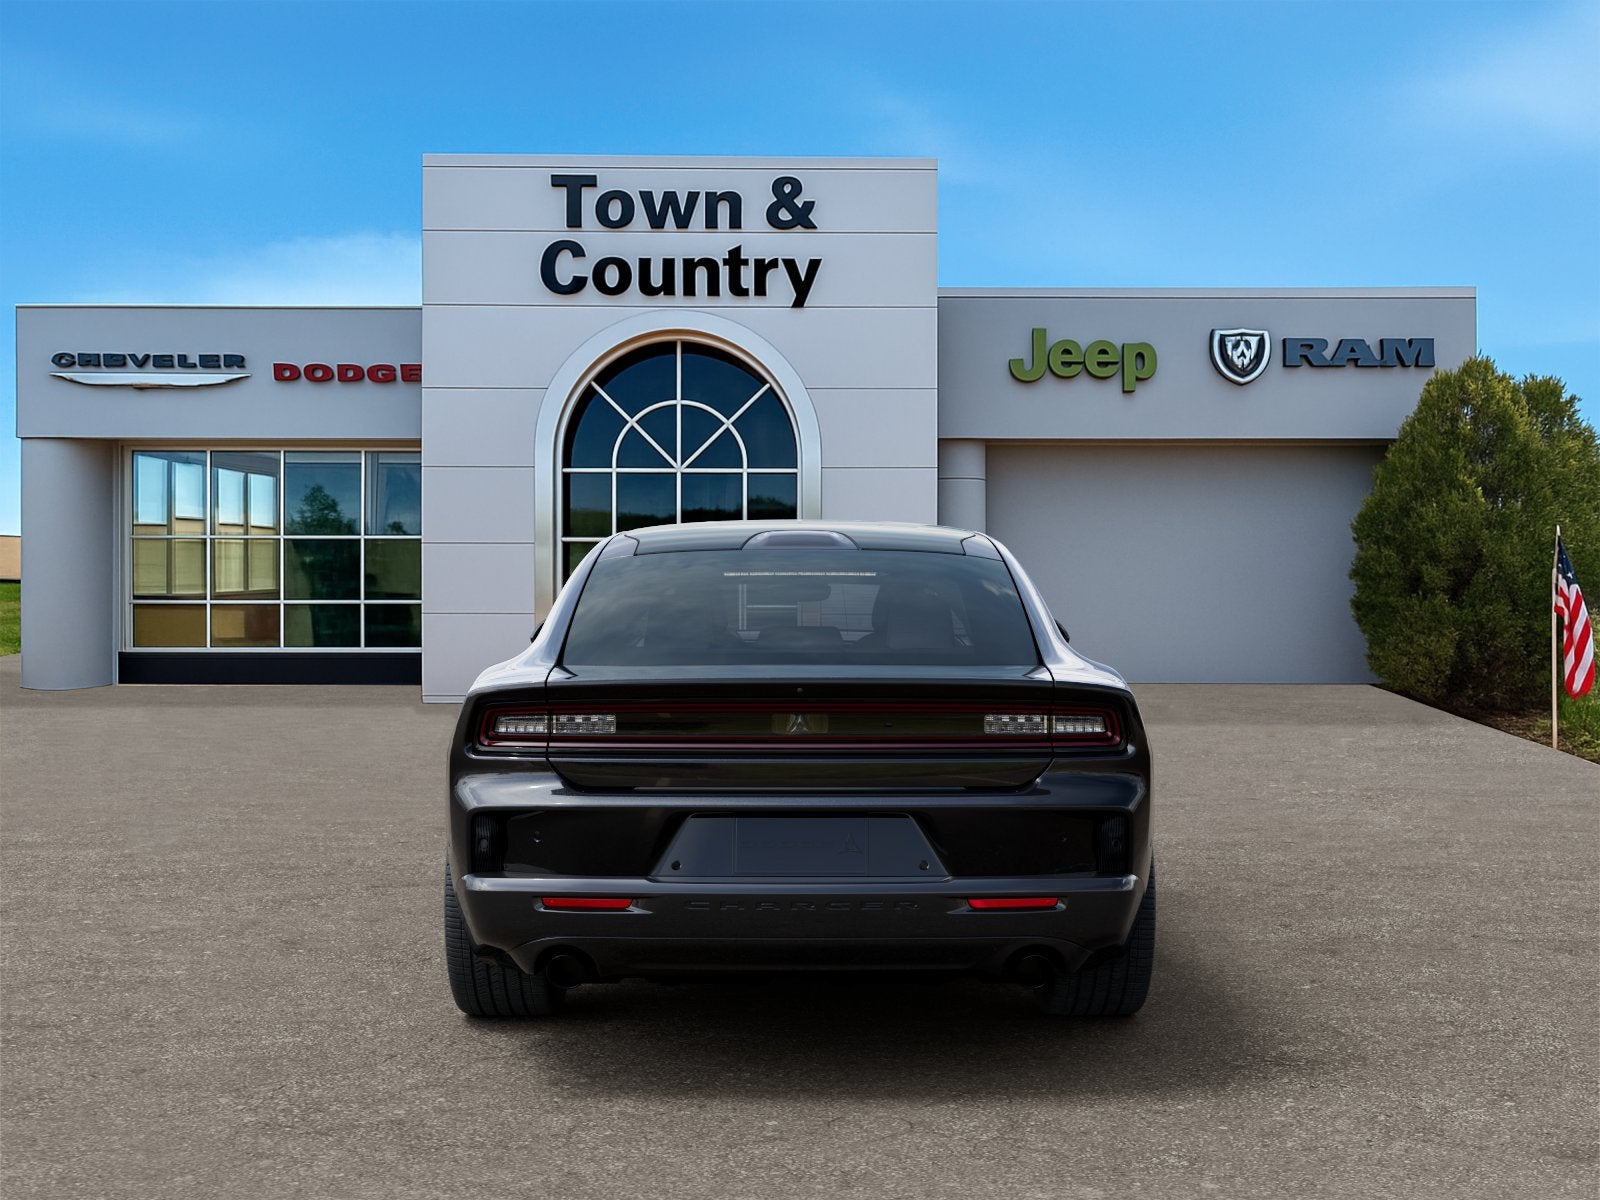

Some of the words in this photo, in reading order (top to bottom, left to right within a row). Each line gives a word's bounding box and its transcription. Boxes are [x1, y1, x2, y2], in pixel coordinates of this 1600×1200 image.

[550, 174, 743, 230] Town
[765, 175, 818, 230] &
[539, 239, 823, 308] Country
[272, 362, 422, 383] DODGE
[1009, 328, 1158, 392] Jeep
[1283, 337, 1436, 368] RAM
